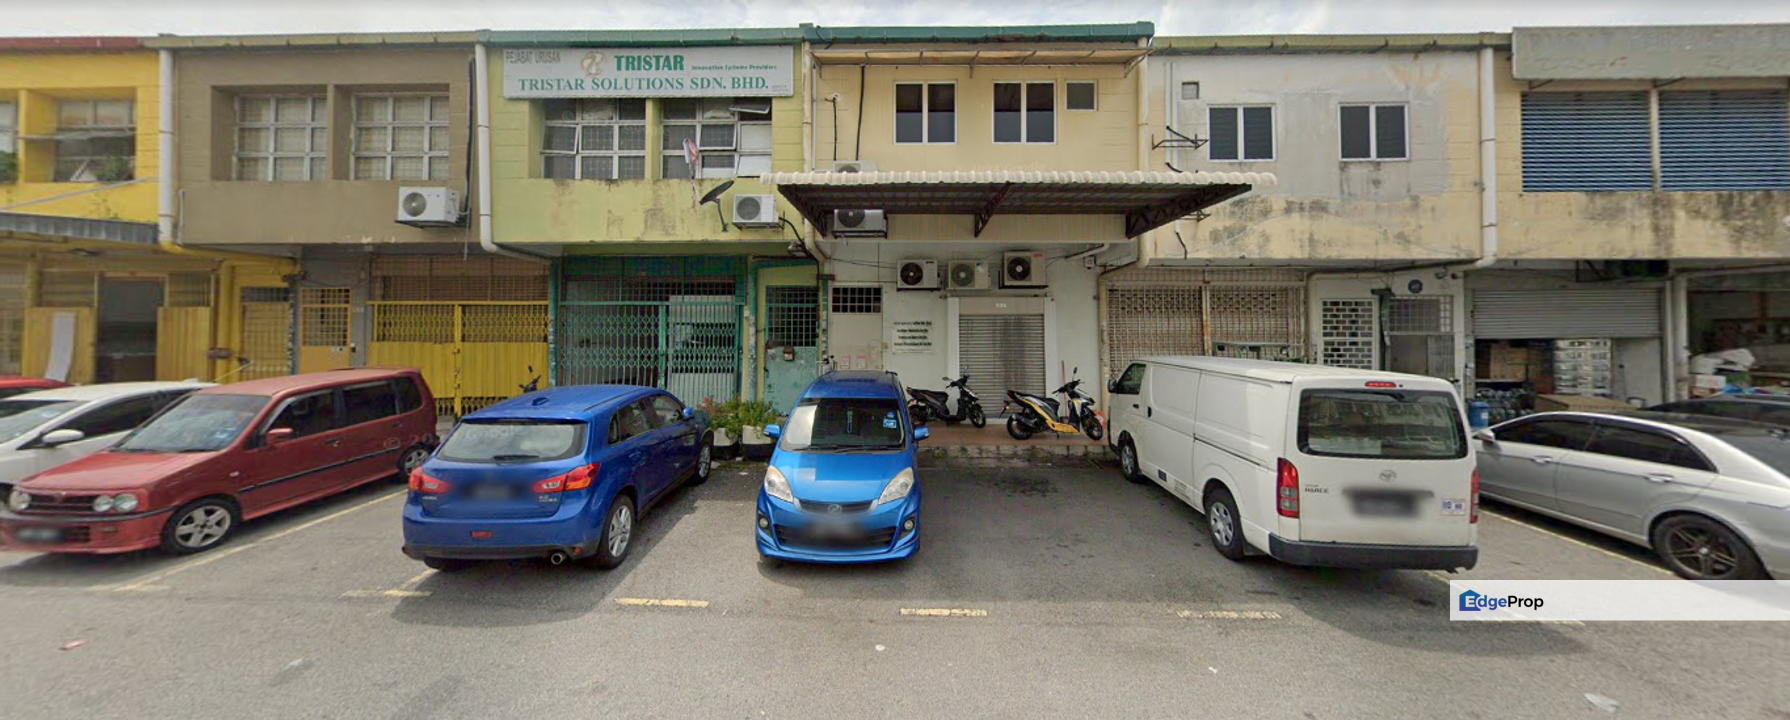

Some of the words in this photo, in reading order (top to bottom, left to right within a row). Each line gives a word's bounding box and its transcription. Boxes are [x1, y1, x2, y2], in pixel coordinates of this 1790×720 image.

[506, 51, 533, 63] PEJABAT
[535, 50, 561, 63] URUSAN
[614, 54, 685, 71] TRISTAR
[518, 78, 585, 91] TRISTAR
[591, 76, 685, 90] SOLUTIONS
[689, 76, 727, 90] SDN.
[731, 76, 769, 89] BHD.
